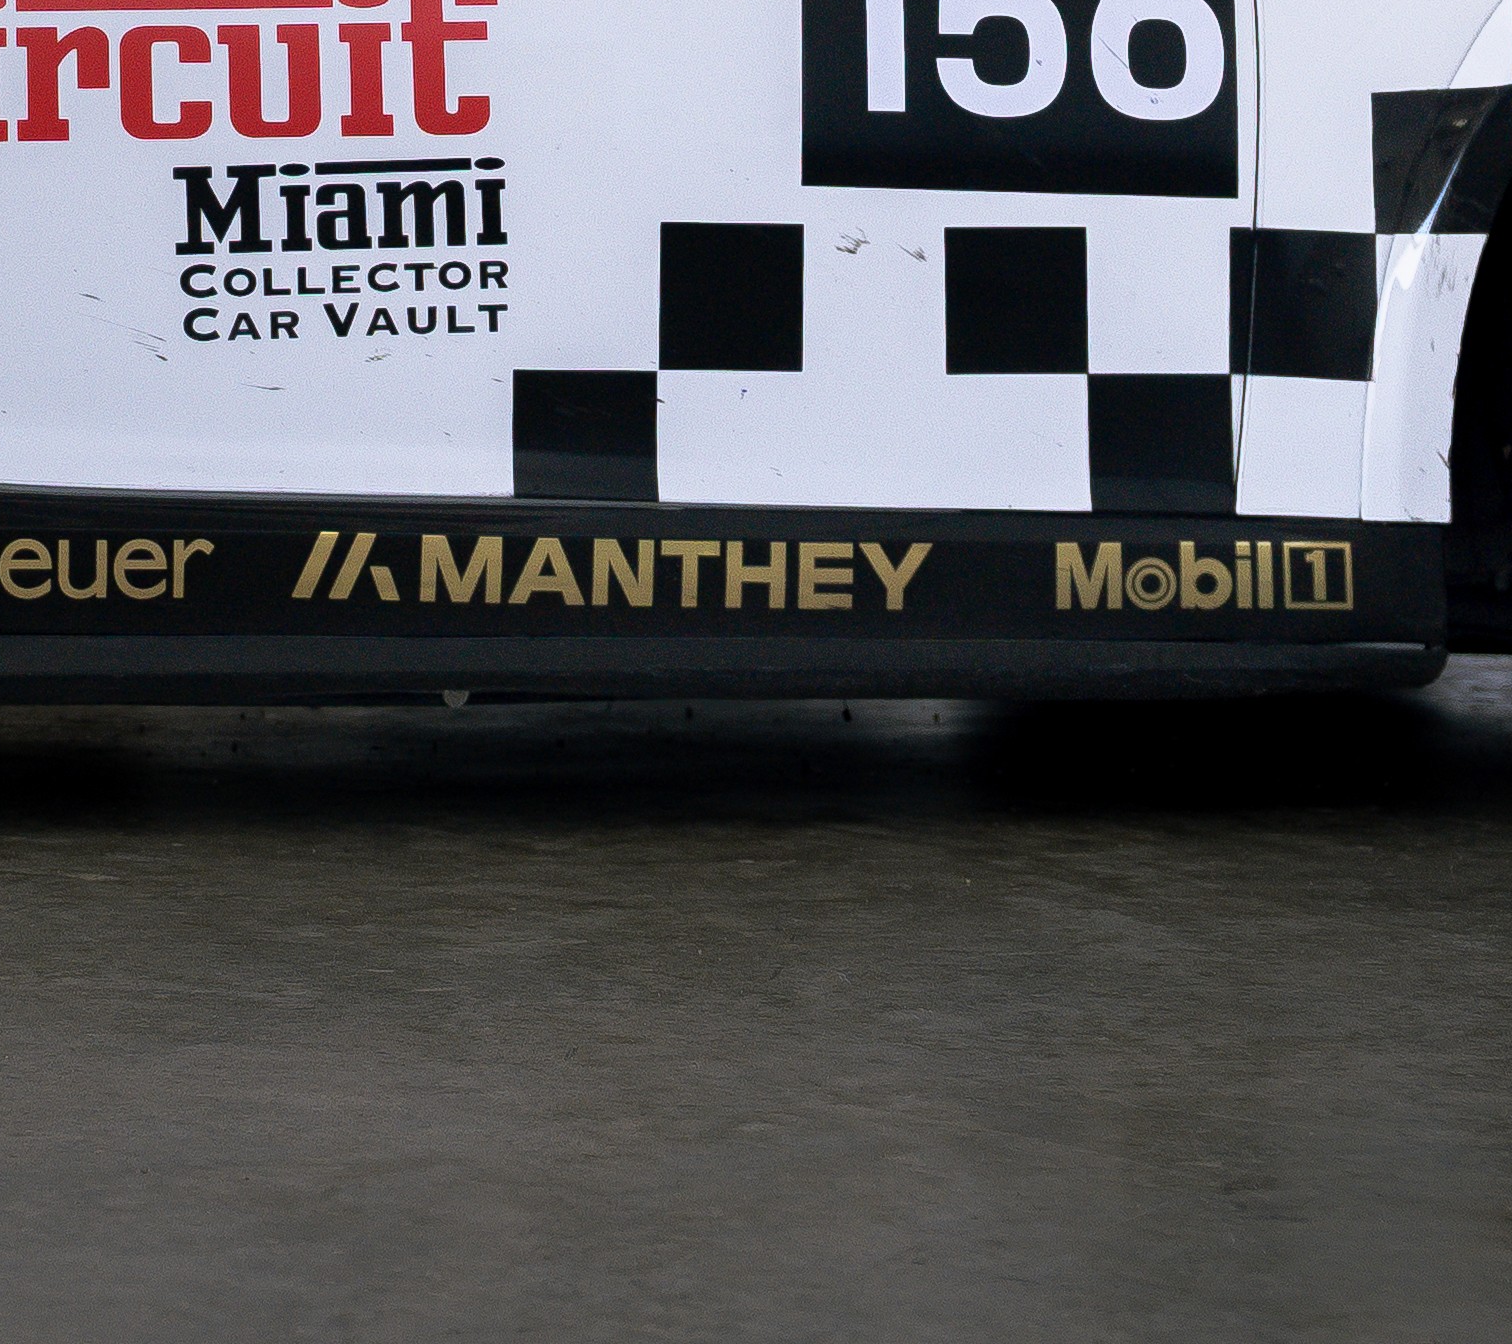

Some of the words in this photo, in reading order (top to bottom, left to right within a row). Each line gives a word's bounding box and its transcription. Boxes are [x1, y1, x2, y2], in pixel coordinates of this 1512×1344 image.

[172, 156, 508, 256] Miami
[179, 260, 509, 300] COLLECTOR
[181, 307, 301, 342] CAR
[323, 301, 509, 340] VAULT
[418, 532, 934, 610] MANTHEY
